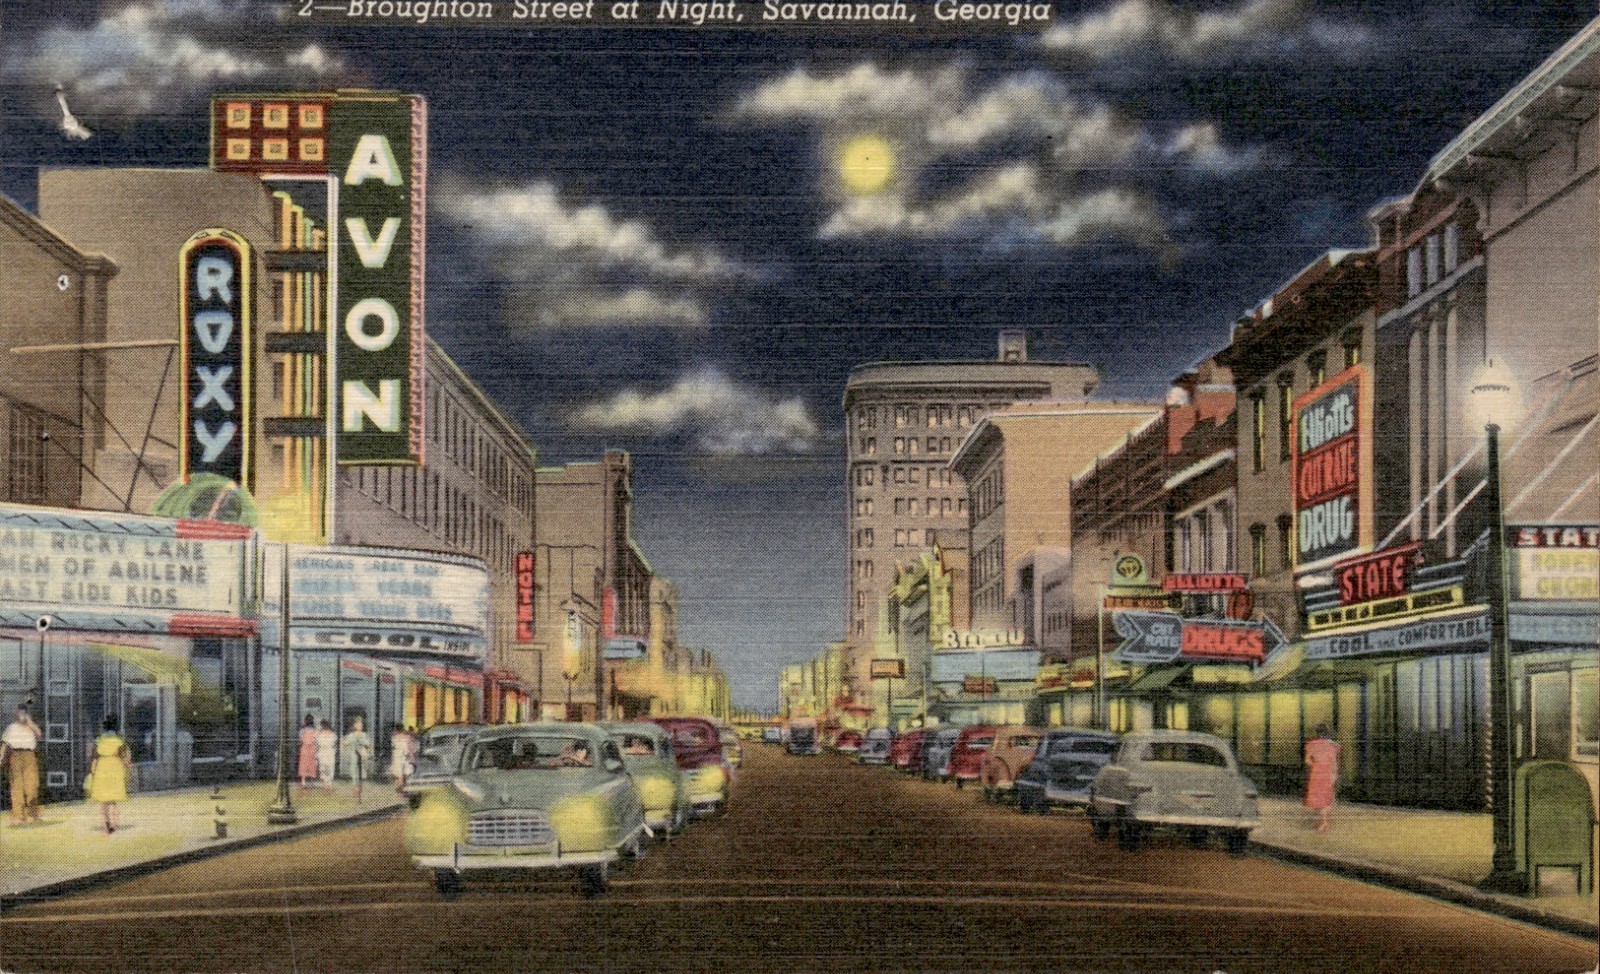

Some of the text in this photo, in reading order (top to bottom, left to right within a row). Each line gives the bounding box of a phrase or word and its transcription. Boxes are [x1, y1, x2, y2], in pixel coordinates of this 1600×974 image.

[342, 133, 404, 433] AVON
[193, 255, 237, 463] ROXY
[1300, 494, 1353, 552] DRUG
[51, 531, 127, 555] ROCKY
[143, 539, 204, 561] LANE
[63, 557, 96, 577] OF
[108, 560, 208, 585] ABILENE
[1342, 555, 1405, 602] STATE
[61, 581, 111, 602] SIDE
[126, 585, 178, 606] KIDS
[314, 631, 439, 650] COOL
[1145, 635, 1179, 647] RATE
[1182, 624, 1264, 655] DRUGS
[1329, 632, 1374, 655] COOL
